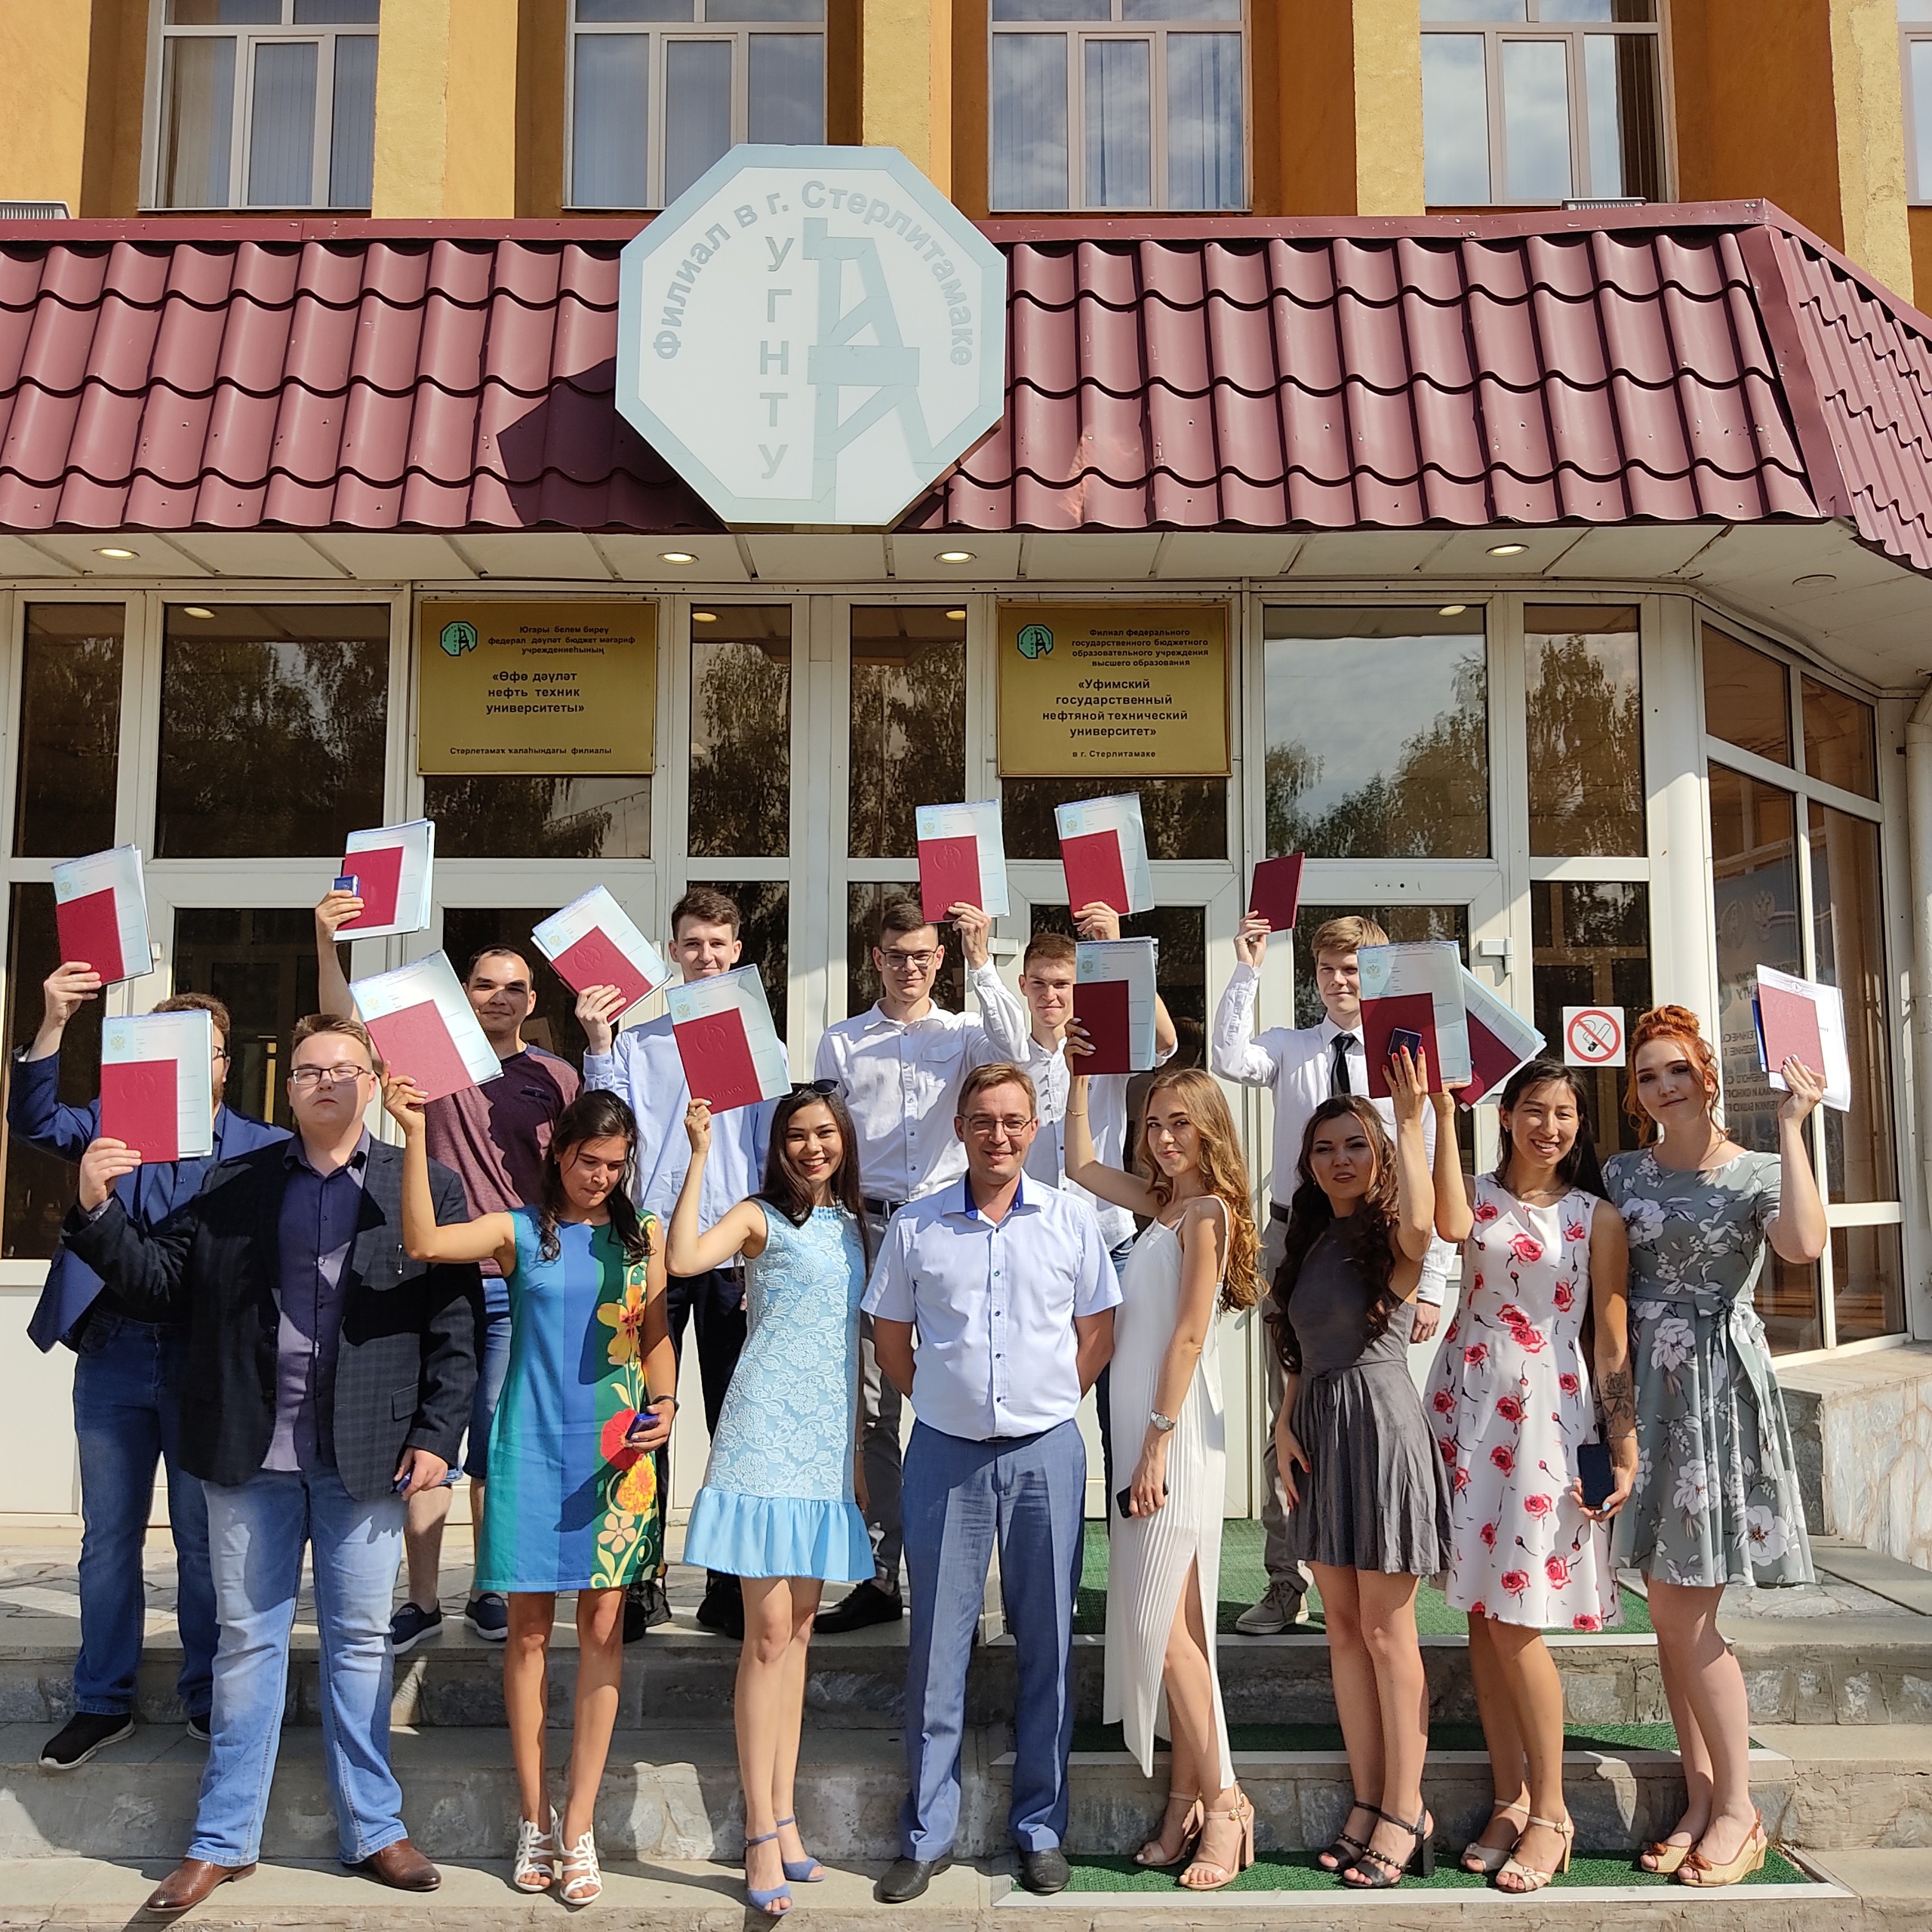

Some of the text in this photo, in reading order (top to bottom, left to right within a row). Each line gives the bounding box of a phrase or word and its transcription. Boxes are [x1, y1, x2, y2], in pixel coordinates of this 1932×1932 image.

[652, 180, 974, 367] Филиал в г. Стерлитамаке
[554, 625, 581, 633] белем
[1125, 628, 1190, 638] федерального
[488, 636, 526, 646] федерал
[565, 636, 598, 646] бюджет
[1072, 638, 1208, 648] государственного бюджетного
[1072, 649, 1209, 658] образовательного учреждения
[1133, 658, 1190, 668] образования
[1078, 678, 1150, 692] «Уфимский
[488, 687, 580, 700] нефть техник
[1056, 694, 1172, 707] государственный
[485, 703, 585, 715] университеты»
[1042, 709, 1188, 723] нефтяной технический
[1069, 727, 1157, 739] университет»
[571, 746, 612, 755] филиалы
[1089, 749, 1156, 759] Стерлитамаке
